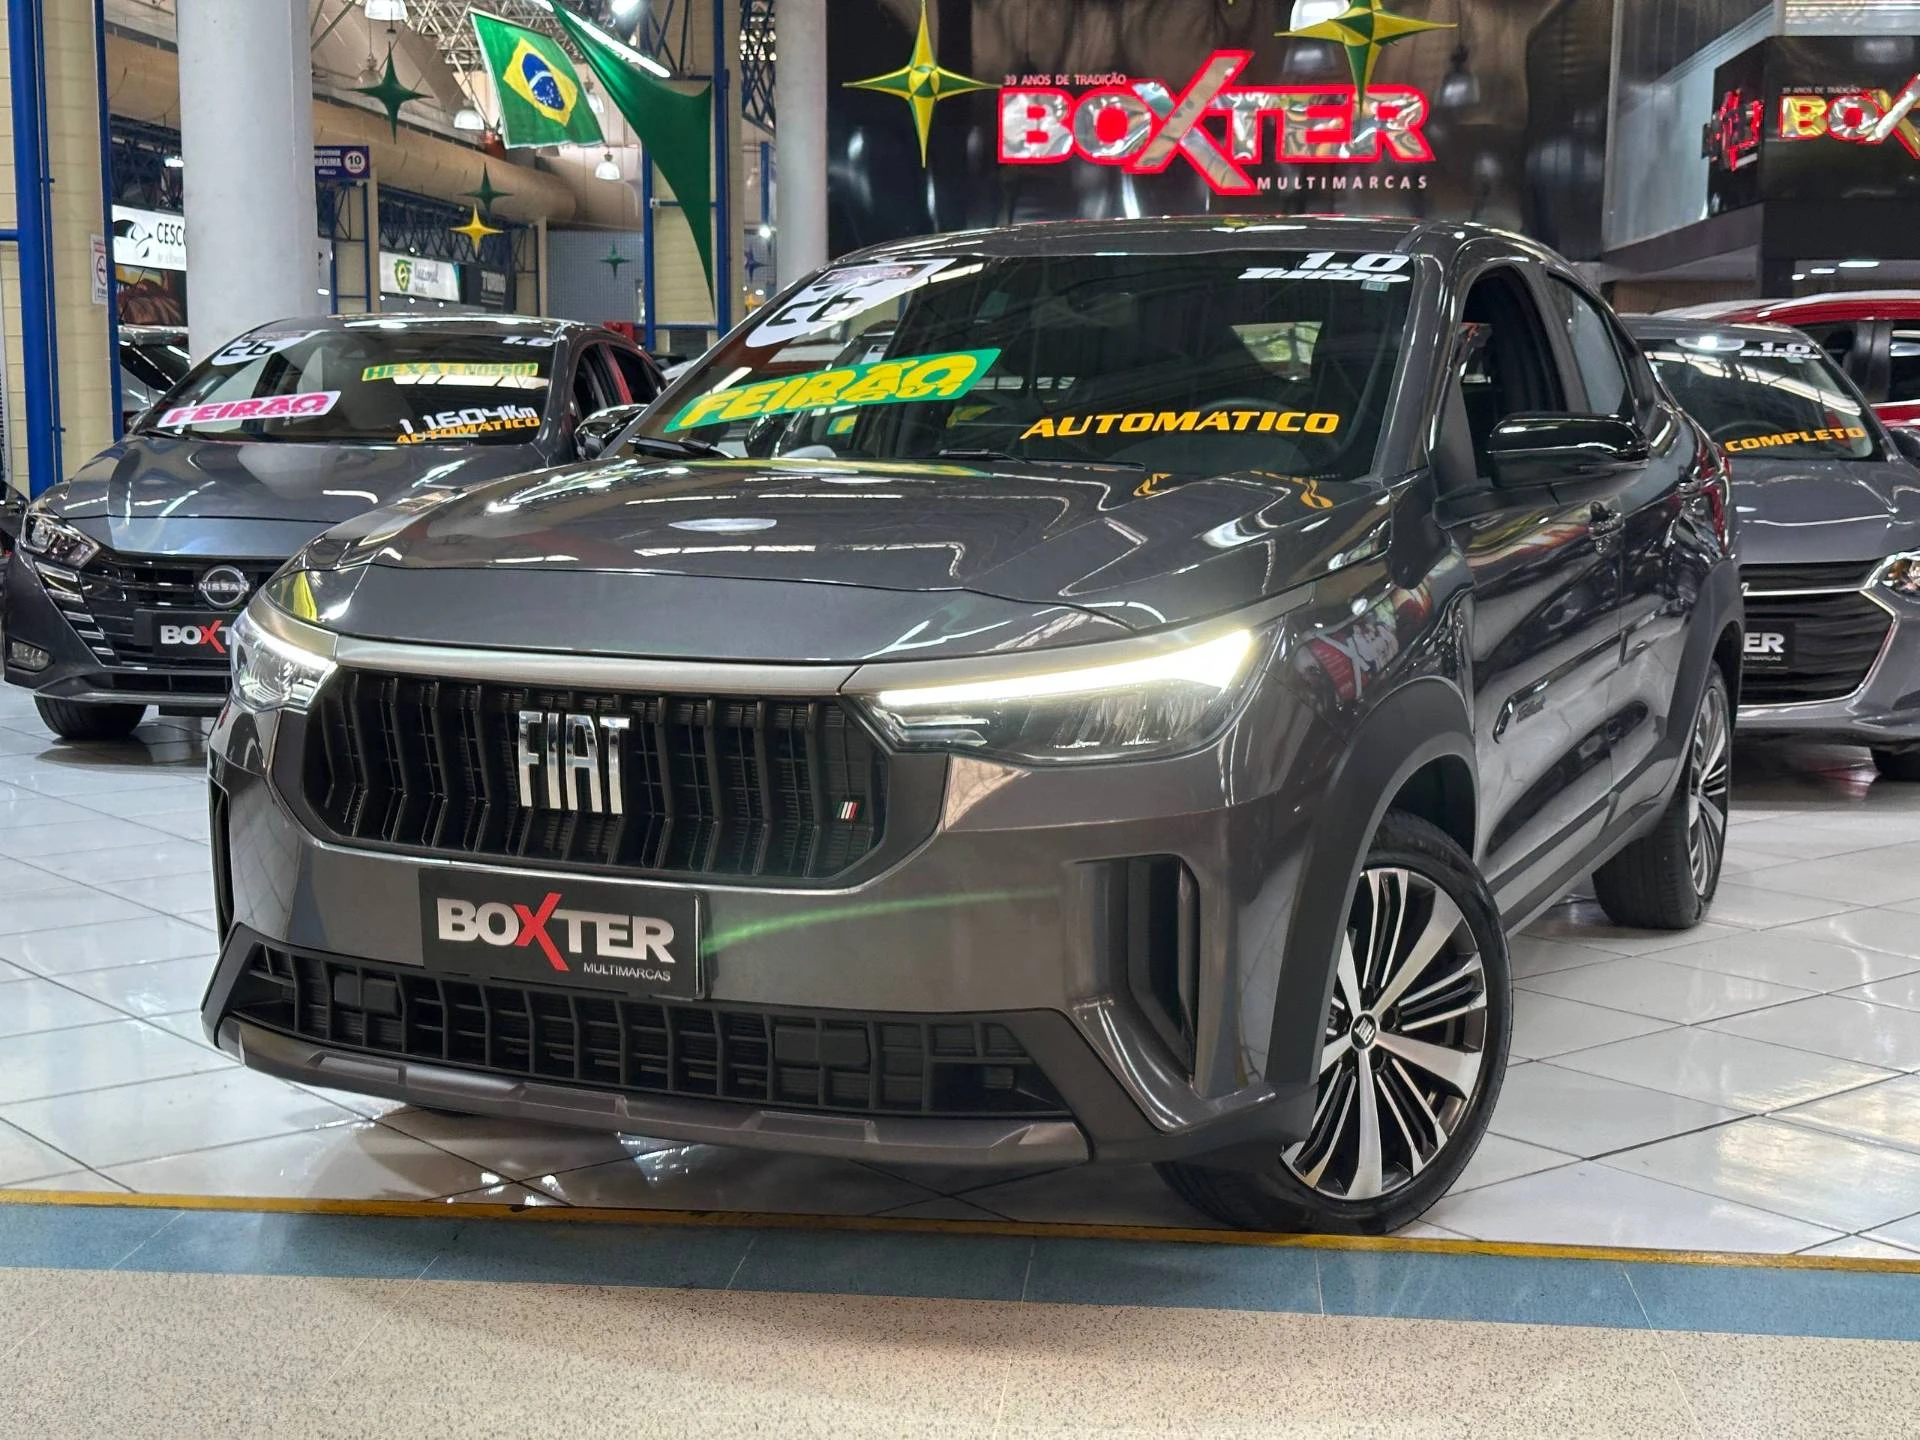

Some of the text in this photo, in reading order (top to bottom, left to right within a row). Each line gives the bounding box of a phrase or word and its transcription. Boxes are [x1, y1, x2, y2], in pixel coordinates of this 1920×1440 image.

[1004, 72, 1127, 86] 39 ANOS DE TRADIÇÃO
[998, 50, 1436, 195] BOXTER
[1777, 70, 1920, 160] BOX
[347, 155, 362, 165] 10
[1256, 176, 1427, 190] MULTIMARCAS
[157, 222, 185, 247] CESC
[1299, 251, 1410, 272] 1.0
[1760, 341, 1811, 354] 1.0
[1725, 427, 1865, 452] COMPLETO
[199, 582, 250, 593] NISSAN
[518, 710, 630, 814] FIAT
[437, 892, 676, 972] BOXTER
[583, 962, 671, 982] MULTIMARCAS
